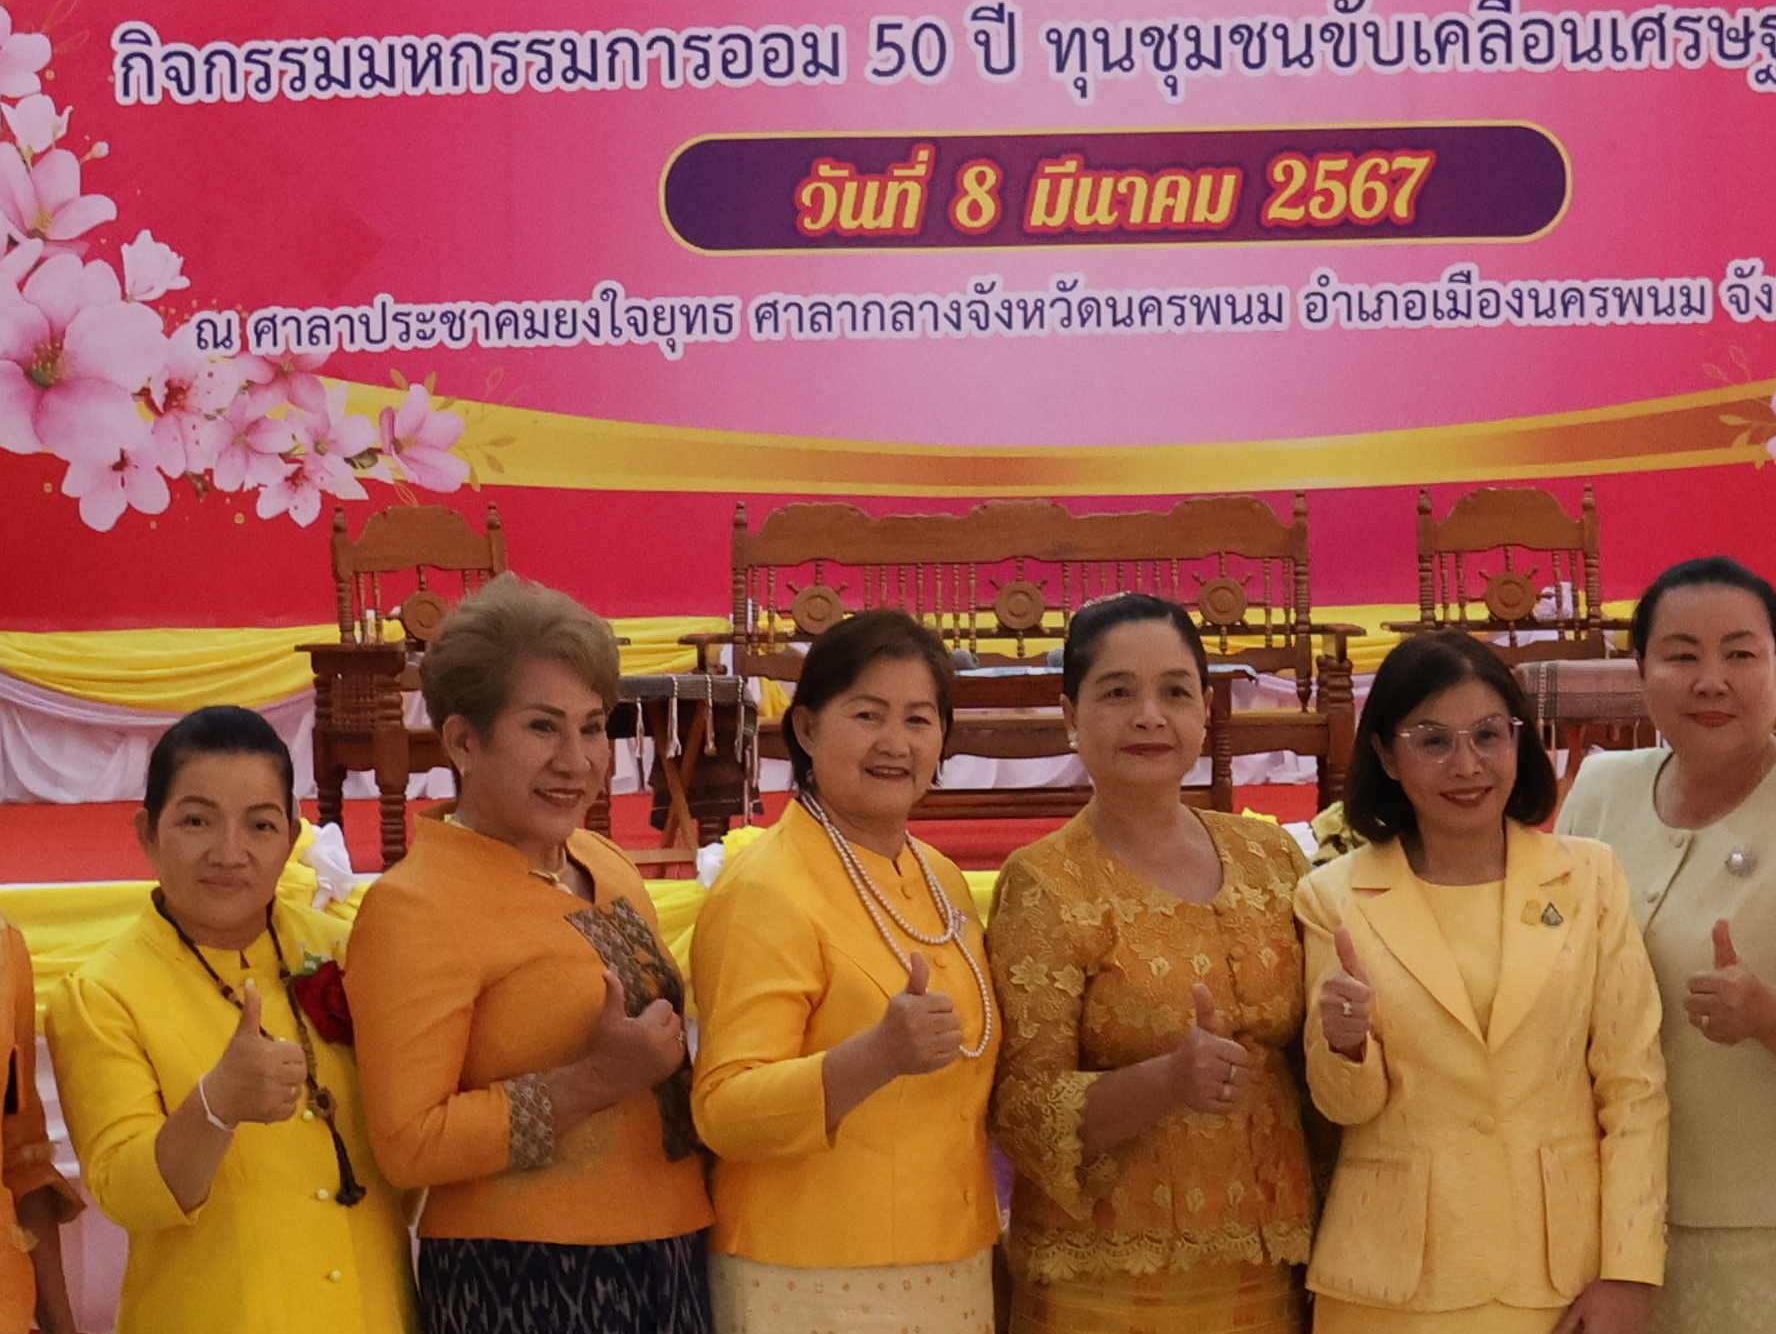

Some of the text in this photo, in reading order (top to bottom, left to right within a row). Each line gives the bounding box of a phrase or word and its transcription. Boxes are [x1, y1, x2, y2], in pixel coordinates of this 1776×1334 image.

[116, 29, 844, 101] กิจกรรมมหกรรมการออม
[870, 23, 948, 82] 50
[971, 4, 1019, 78] ปี
[800, 149, 1432, 231] วันที่ 8 มีนาคม 2567
[194, 312, 232, 351] ณ
[251, 289, 734, 353] ศาลาประชาคมยงใจยุทธ
[753, 279, 1284, 339] ศาลากลางจังหวัดนครพนม
[1303, 269, 1709, 327] อำเภอเมืองนครพนม
